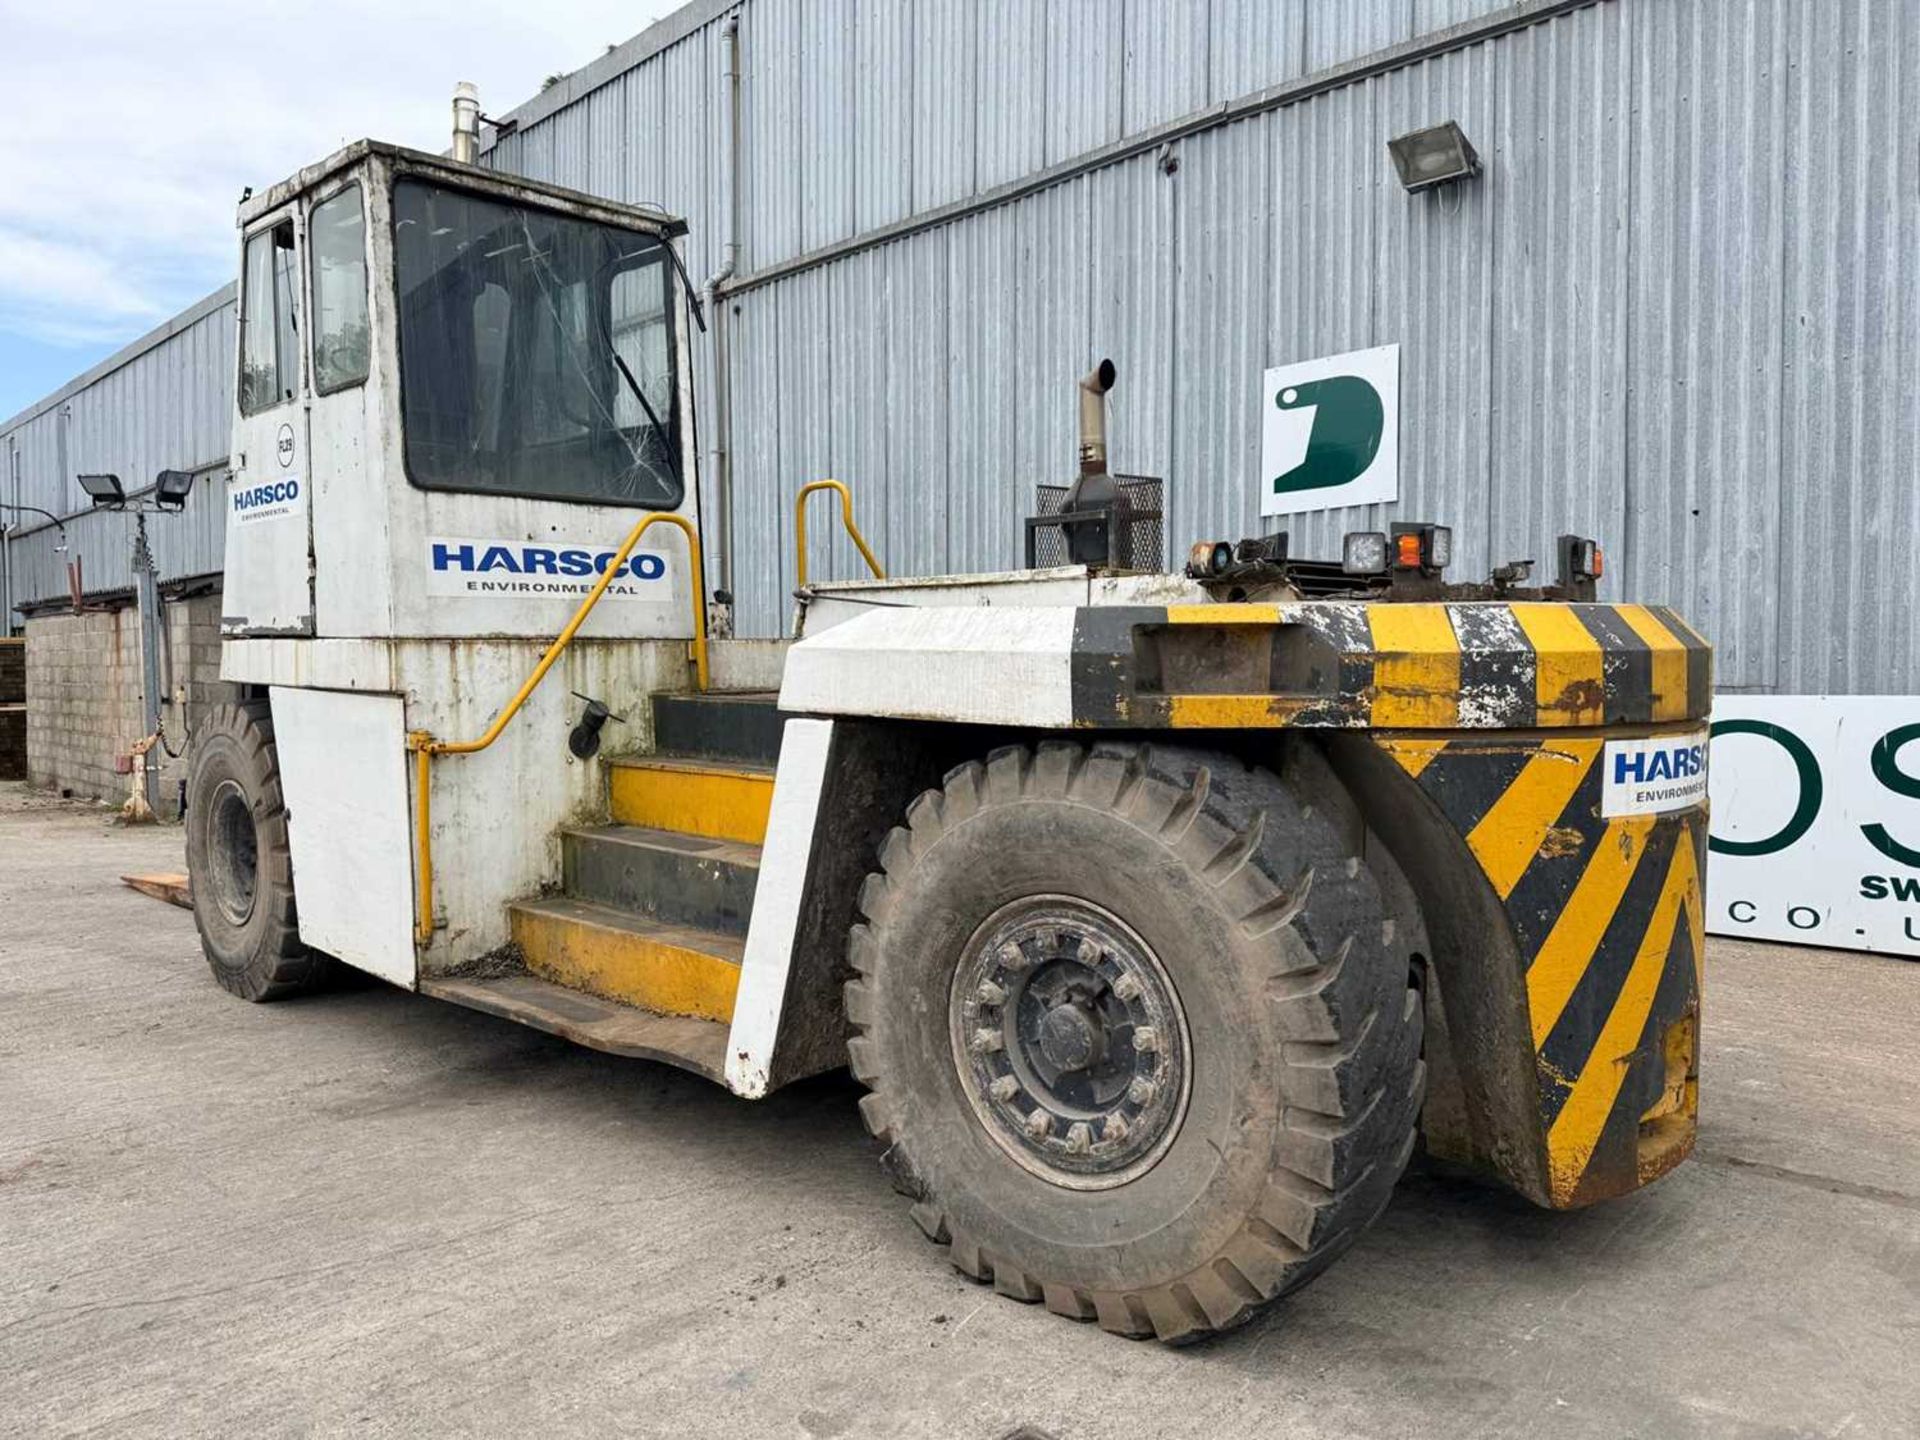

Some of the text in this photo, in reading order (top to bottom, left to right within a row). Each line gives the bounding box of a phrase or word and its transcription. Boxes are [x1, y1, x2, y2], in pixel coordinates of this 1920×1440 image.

[234, 480, 298, 511] HARSCO
[432, 544, 665, 580] HARSCO
[467, 581, 639, 595] ENVIRONMETAL
